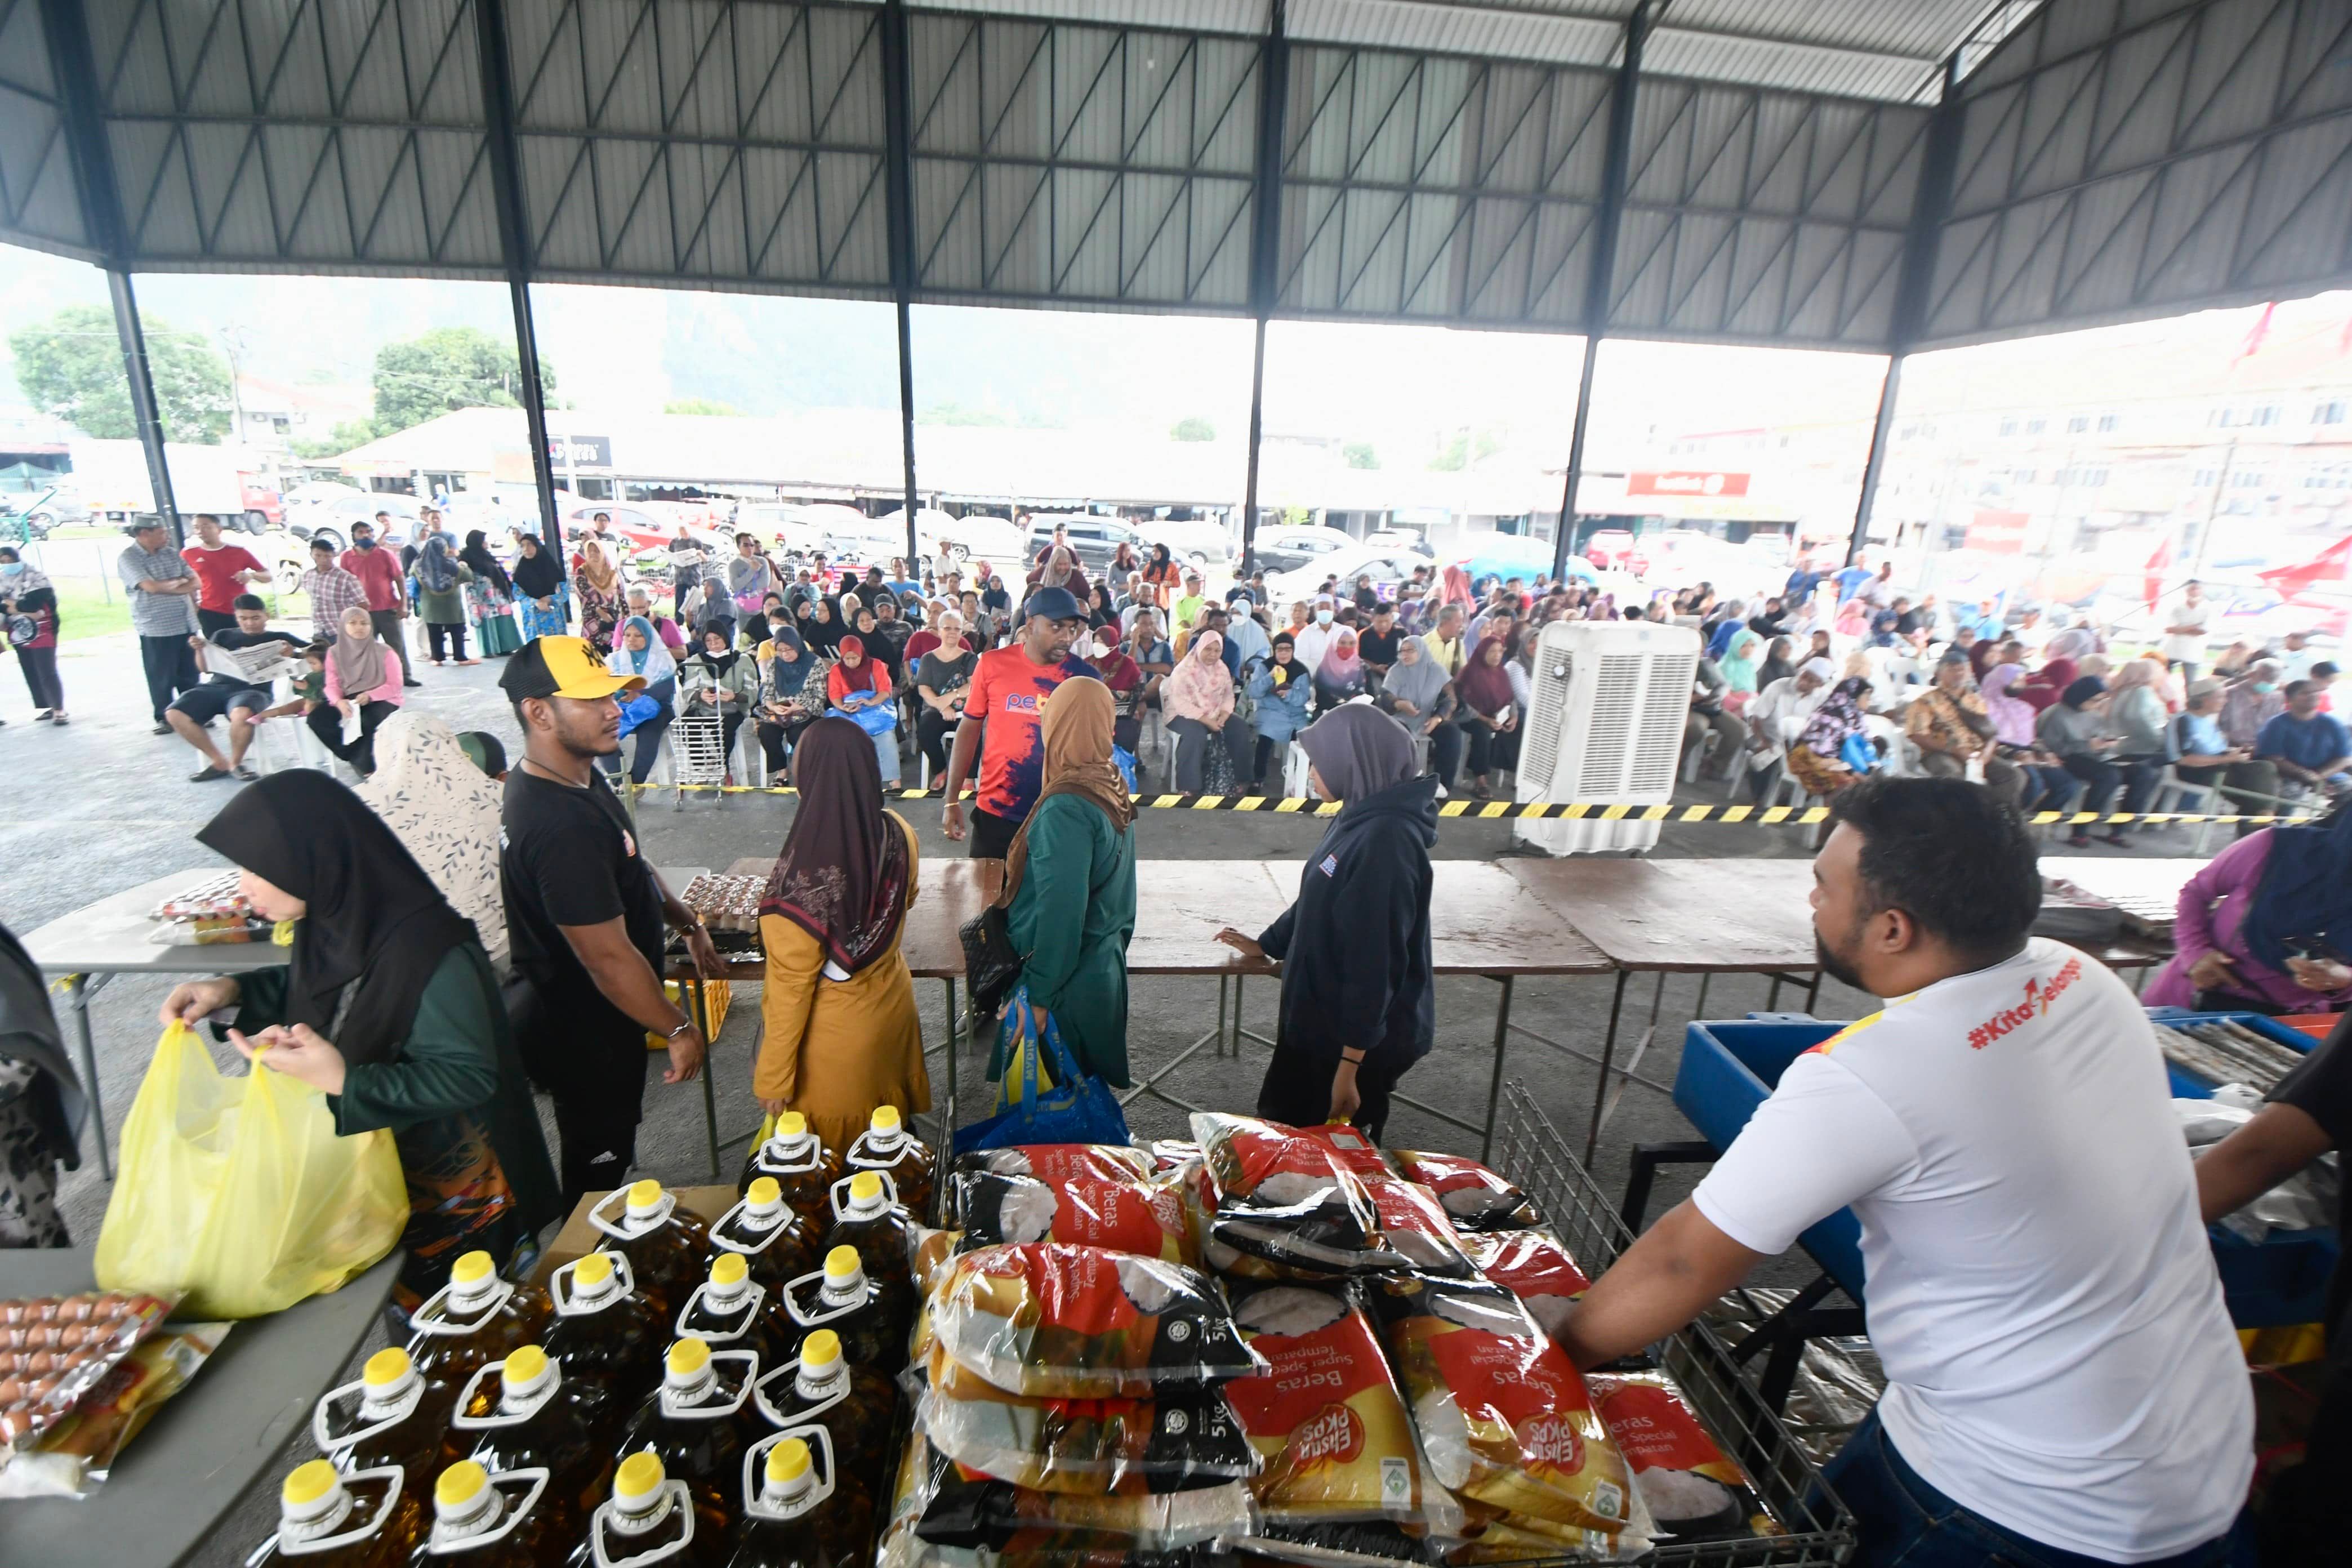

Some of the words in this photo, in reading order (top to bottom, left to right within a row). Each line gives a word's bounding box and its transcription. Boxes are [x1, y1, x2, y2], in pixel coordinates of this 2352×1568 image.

[1071, 1154, 1085, 1180] Bera
[1103, 1190, 1120, 1228] Beras
[1378, 1198, 1414, 1208] eras
[1312, 1355, 1354, 1367] Super
[1276, 1370, 1344, 1392] Beras
[1302, 1407, 1349, 1442] PKPS
[1529, 1420, 1571, 1443] PKPS
[1610, 1416, 1654, 1433] eras
[1629, 1429, 1678, 1443] Special
